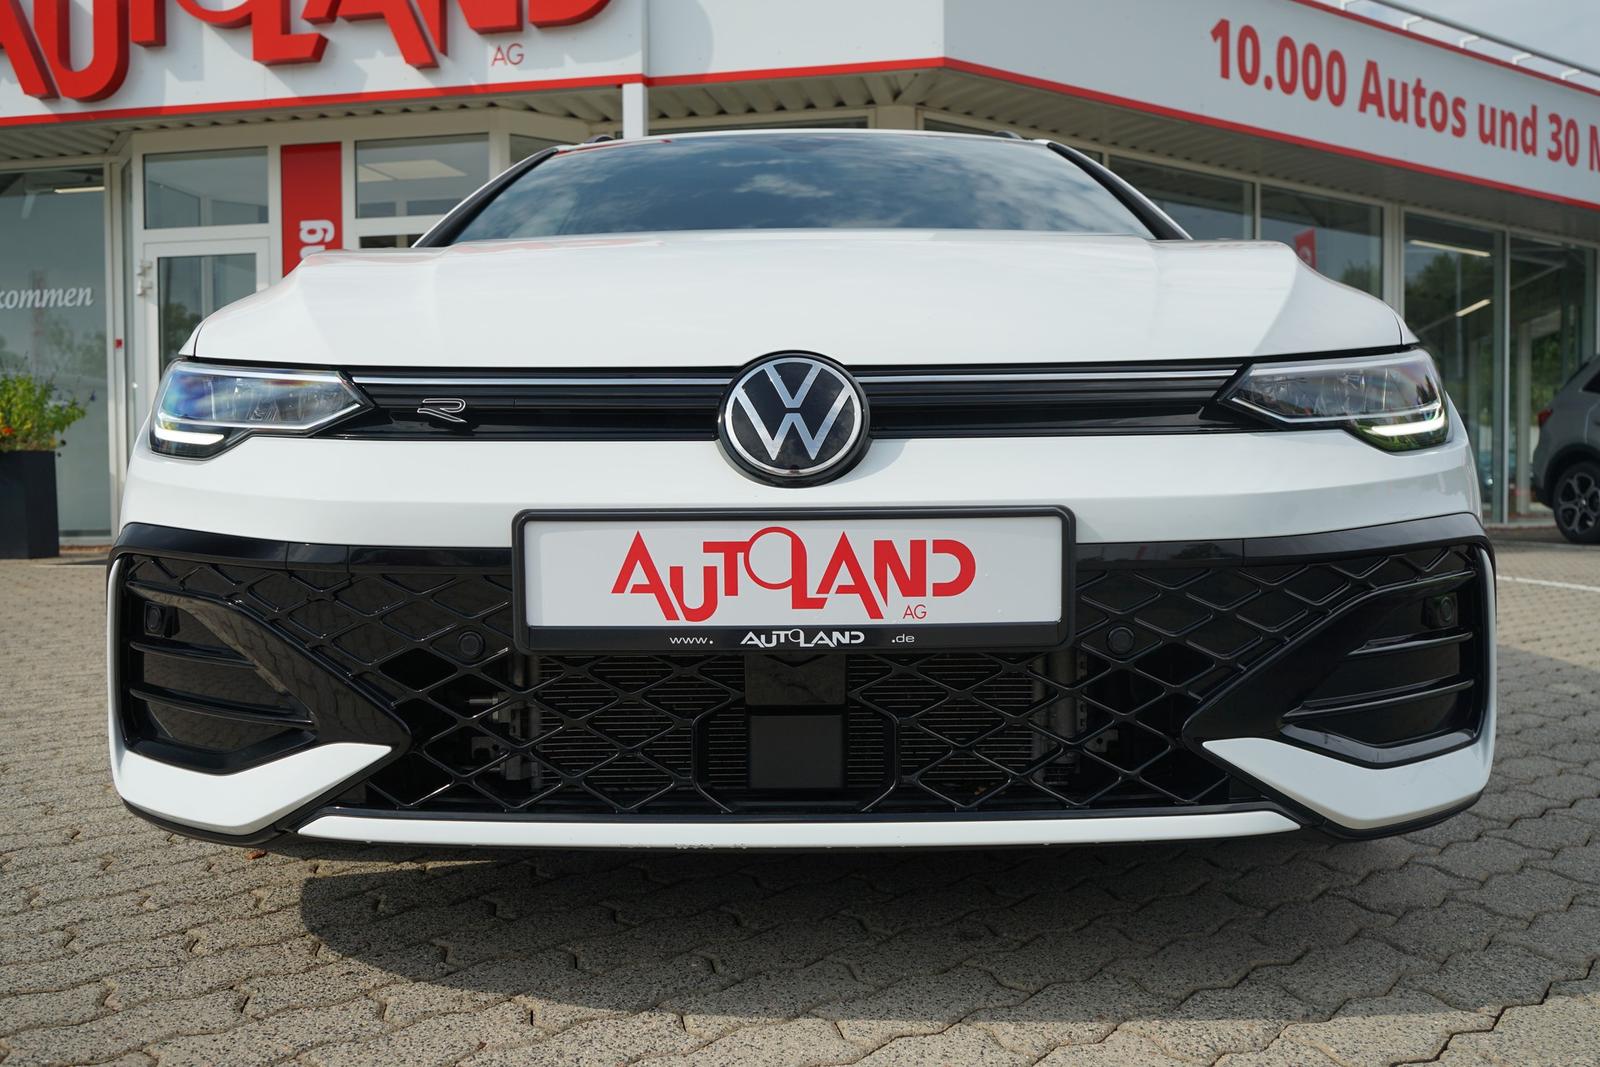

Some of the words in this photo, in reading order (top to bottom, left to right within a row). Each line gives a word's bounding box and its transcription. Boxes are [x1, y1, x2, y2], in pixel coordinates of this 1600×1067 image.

[491, 43, 525, 67] AG
[1211, 18, 1346, 107] 10.000
[1358, 60, 1467, 138] Autos
[1478, 104, 1537, 157] und
[1547, 112, 1579, 167] 30
[611, 526, 976, 623] AUTOLAND
[902, 604, 928, 620] AG
[669, 636, 714, 645] www.
[891, 633, 915, 643] .de
